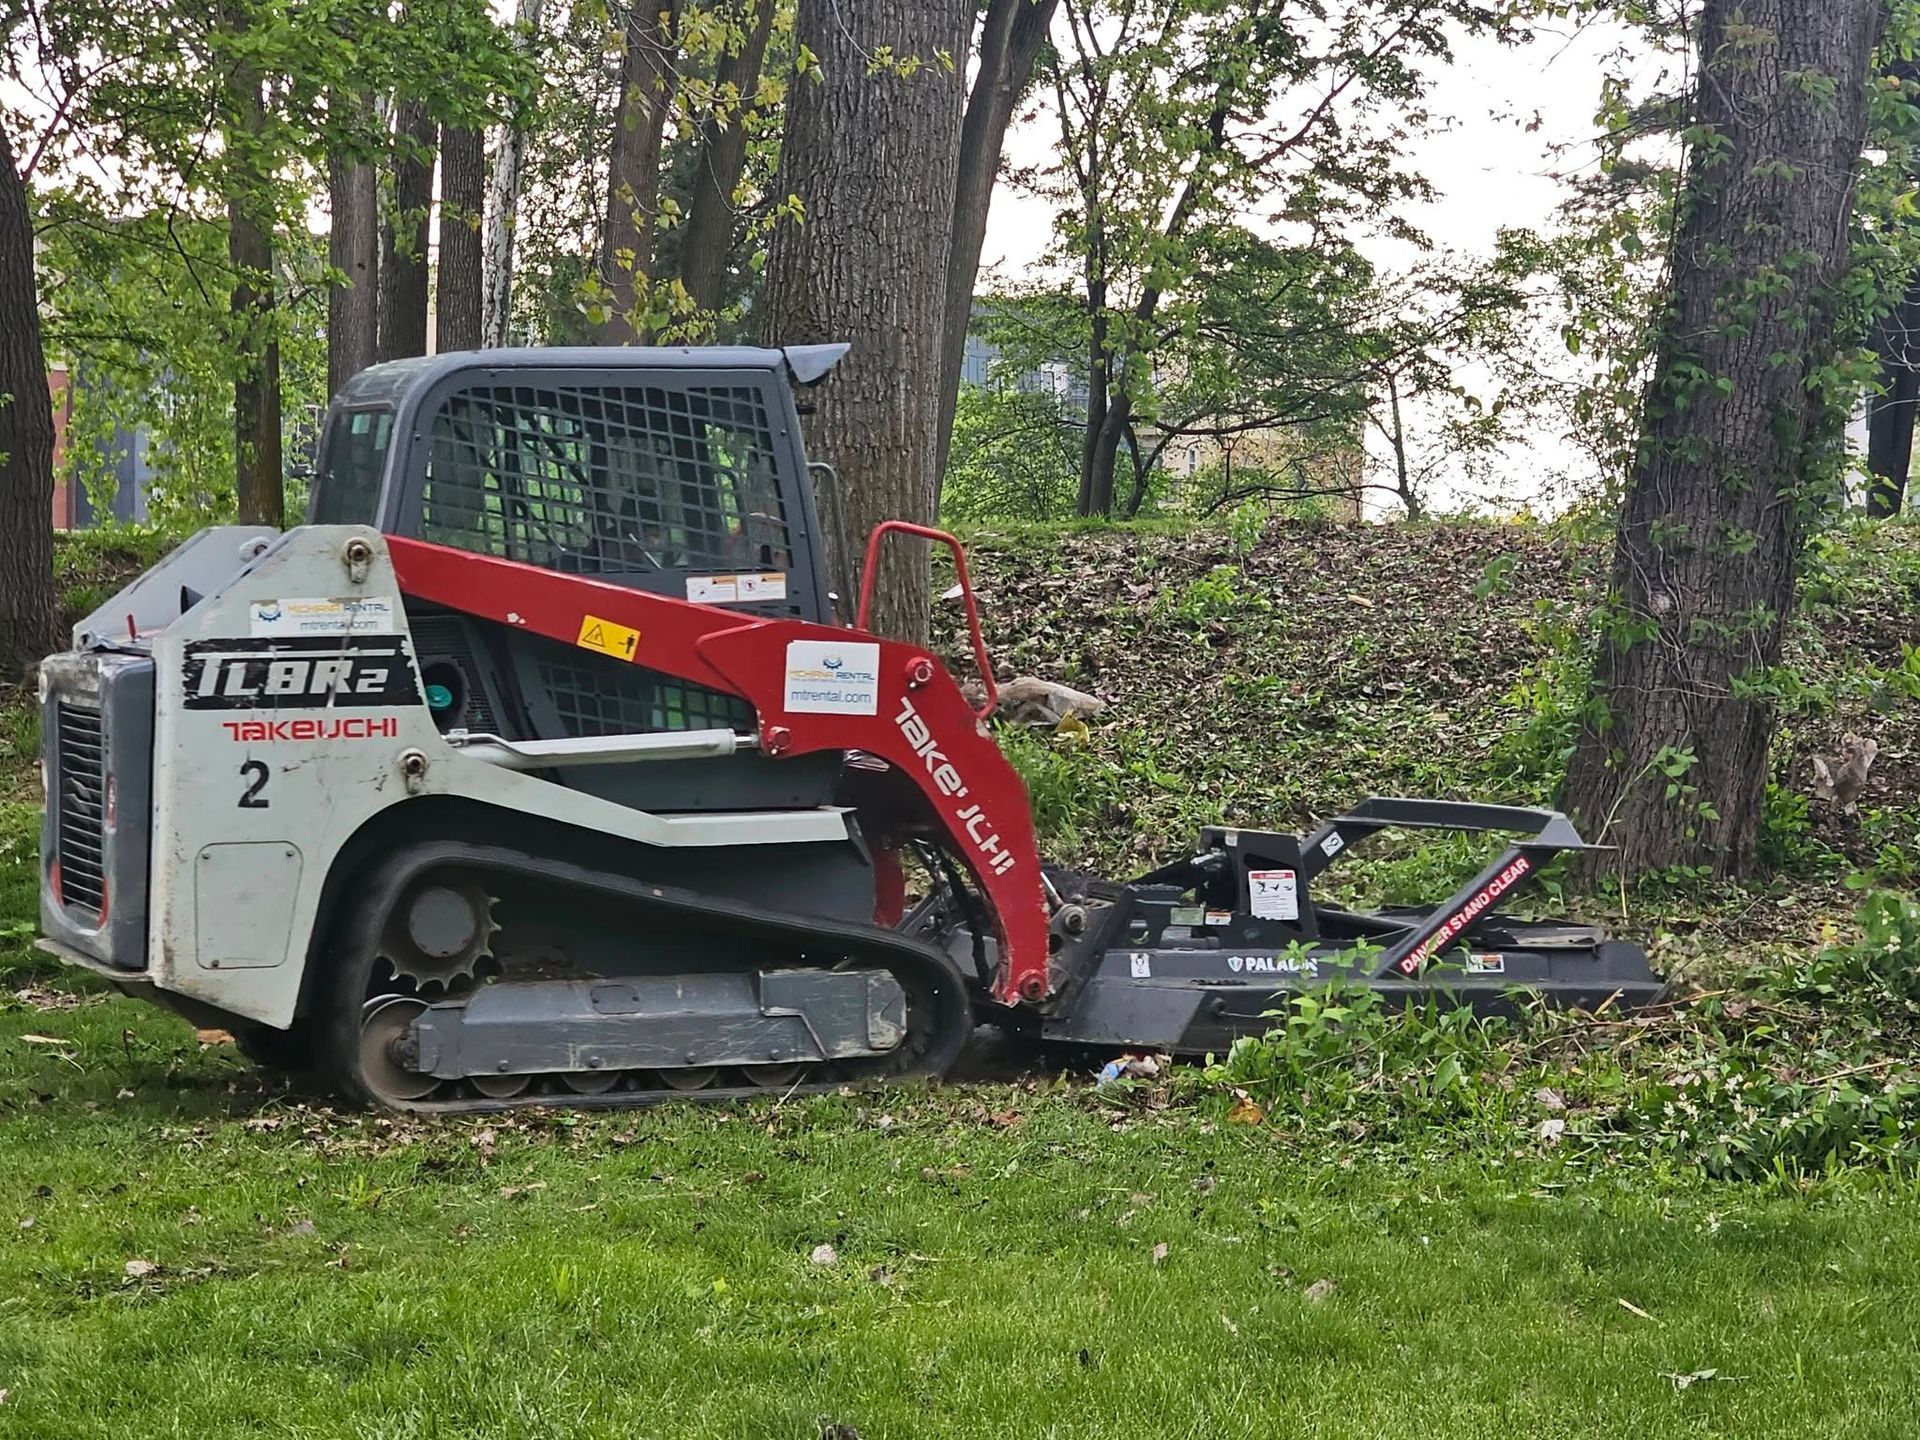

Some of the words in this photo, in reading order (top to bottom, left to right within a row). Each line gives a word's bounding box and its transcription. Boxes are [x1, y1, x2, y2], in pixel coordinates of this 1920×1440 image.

[791, 690, 872, 703] mtrental.com
[238, 760, 269, 808] 2
[1450, 892, 1490, 930] STAND
[1488, 858, 1529, 897] CLEAR
